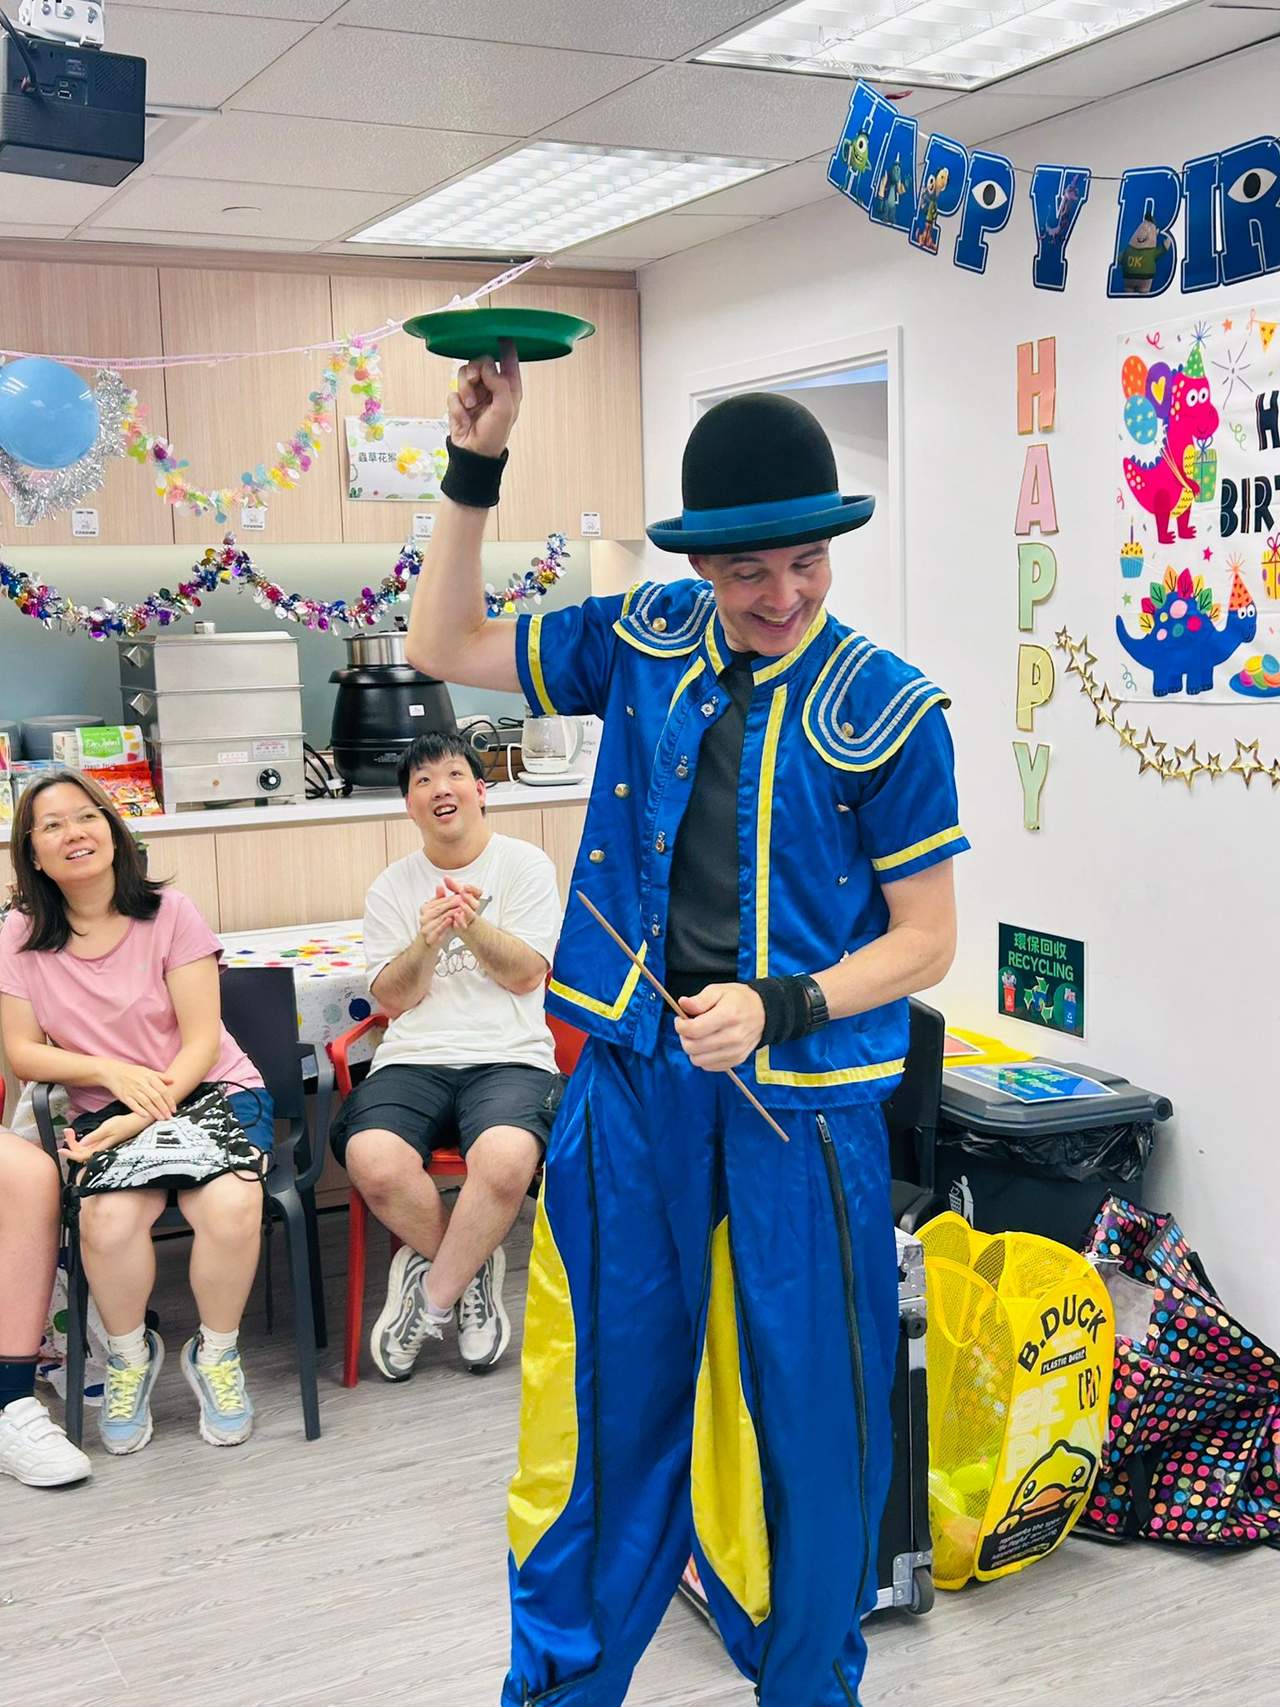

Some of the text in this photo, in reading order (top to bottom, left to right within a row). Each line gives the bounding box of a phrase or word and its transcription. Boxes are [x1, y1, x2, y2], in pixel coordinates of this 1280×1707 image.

[827, 79, 1091, 291] HAPPY
[1220, 474, 1280, 538] BIR
[1014, 335, 1059, 831] HAPPY
[1008, 951, 1074, 981] RECYCLING
[1014, 932, 1067, 960] 環保回收
[1018, 1295, 1107, 1372] B.DUCK
